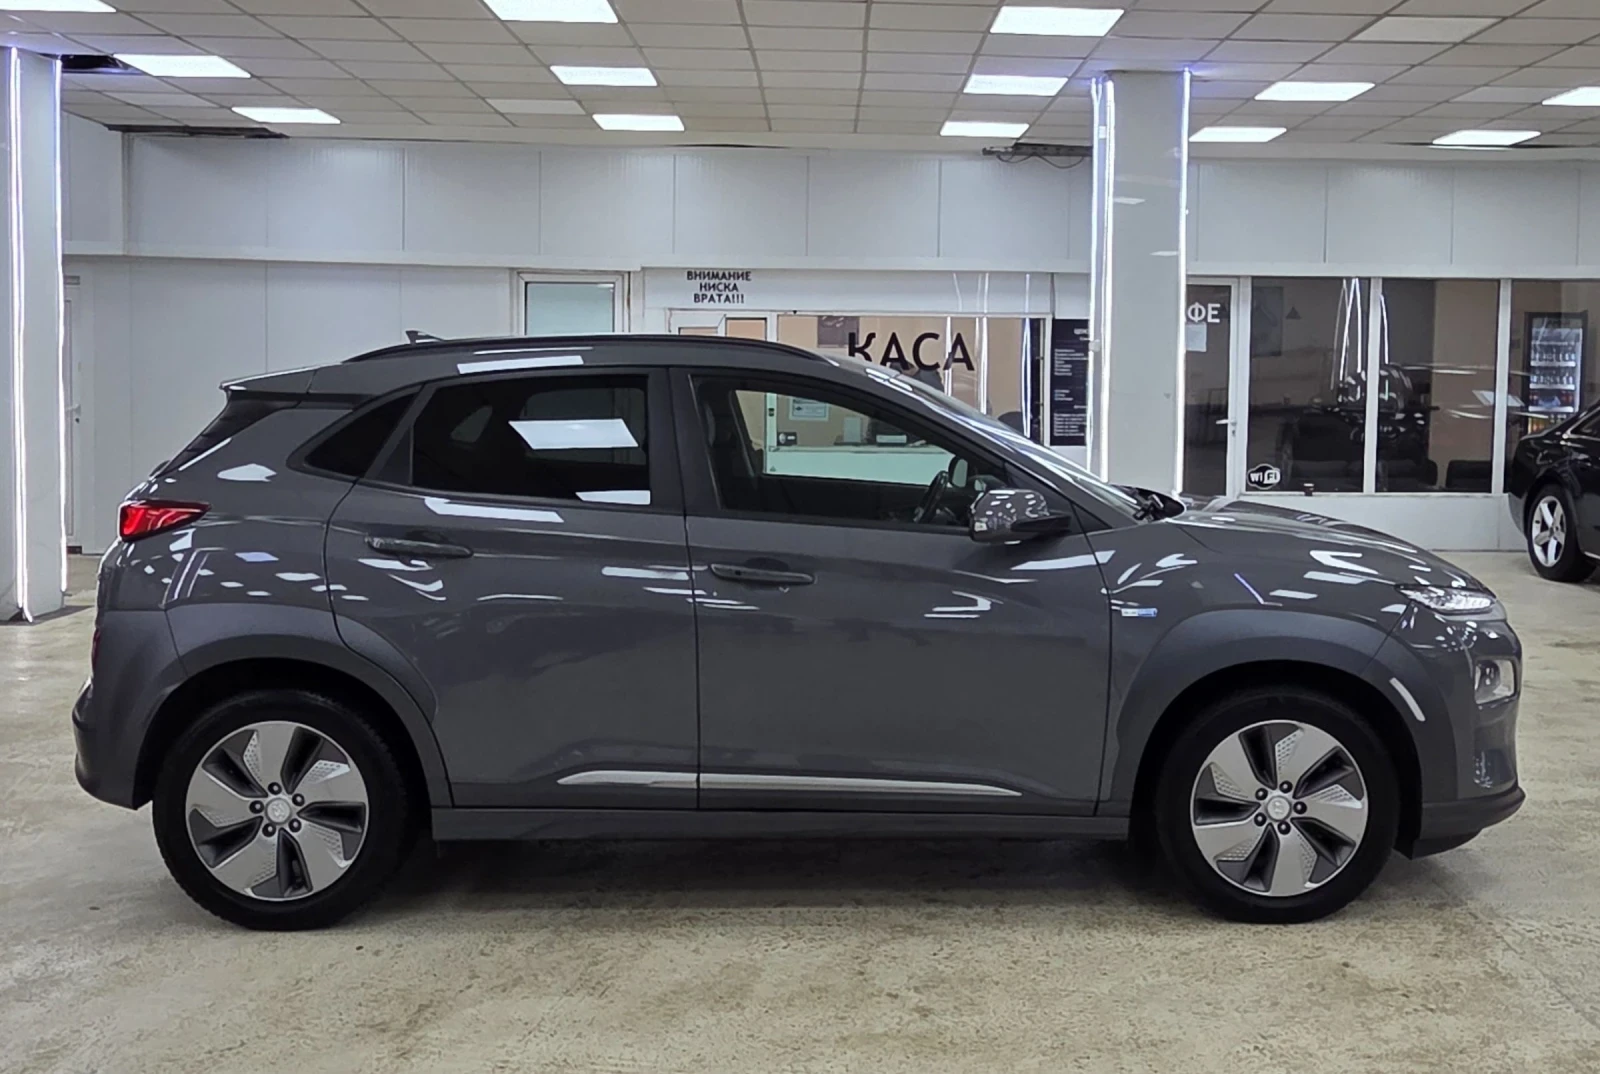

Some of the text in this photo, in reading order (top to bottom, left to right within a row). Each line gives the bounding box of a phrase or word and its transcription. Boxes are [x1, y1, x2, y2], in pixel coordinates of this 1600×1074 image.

[686, 270, 752, 281] ВНИМАНИЕ
[700, 282, 739, 292] НИСКА
[693, 293, 744, 304] ВРАТА!!!
[1185, 302, 1221, 323] ФЕ
[848, 331, 975, 371] КАСА
